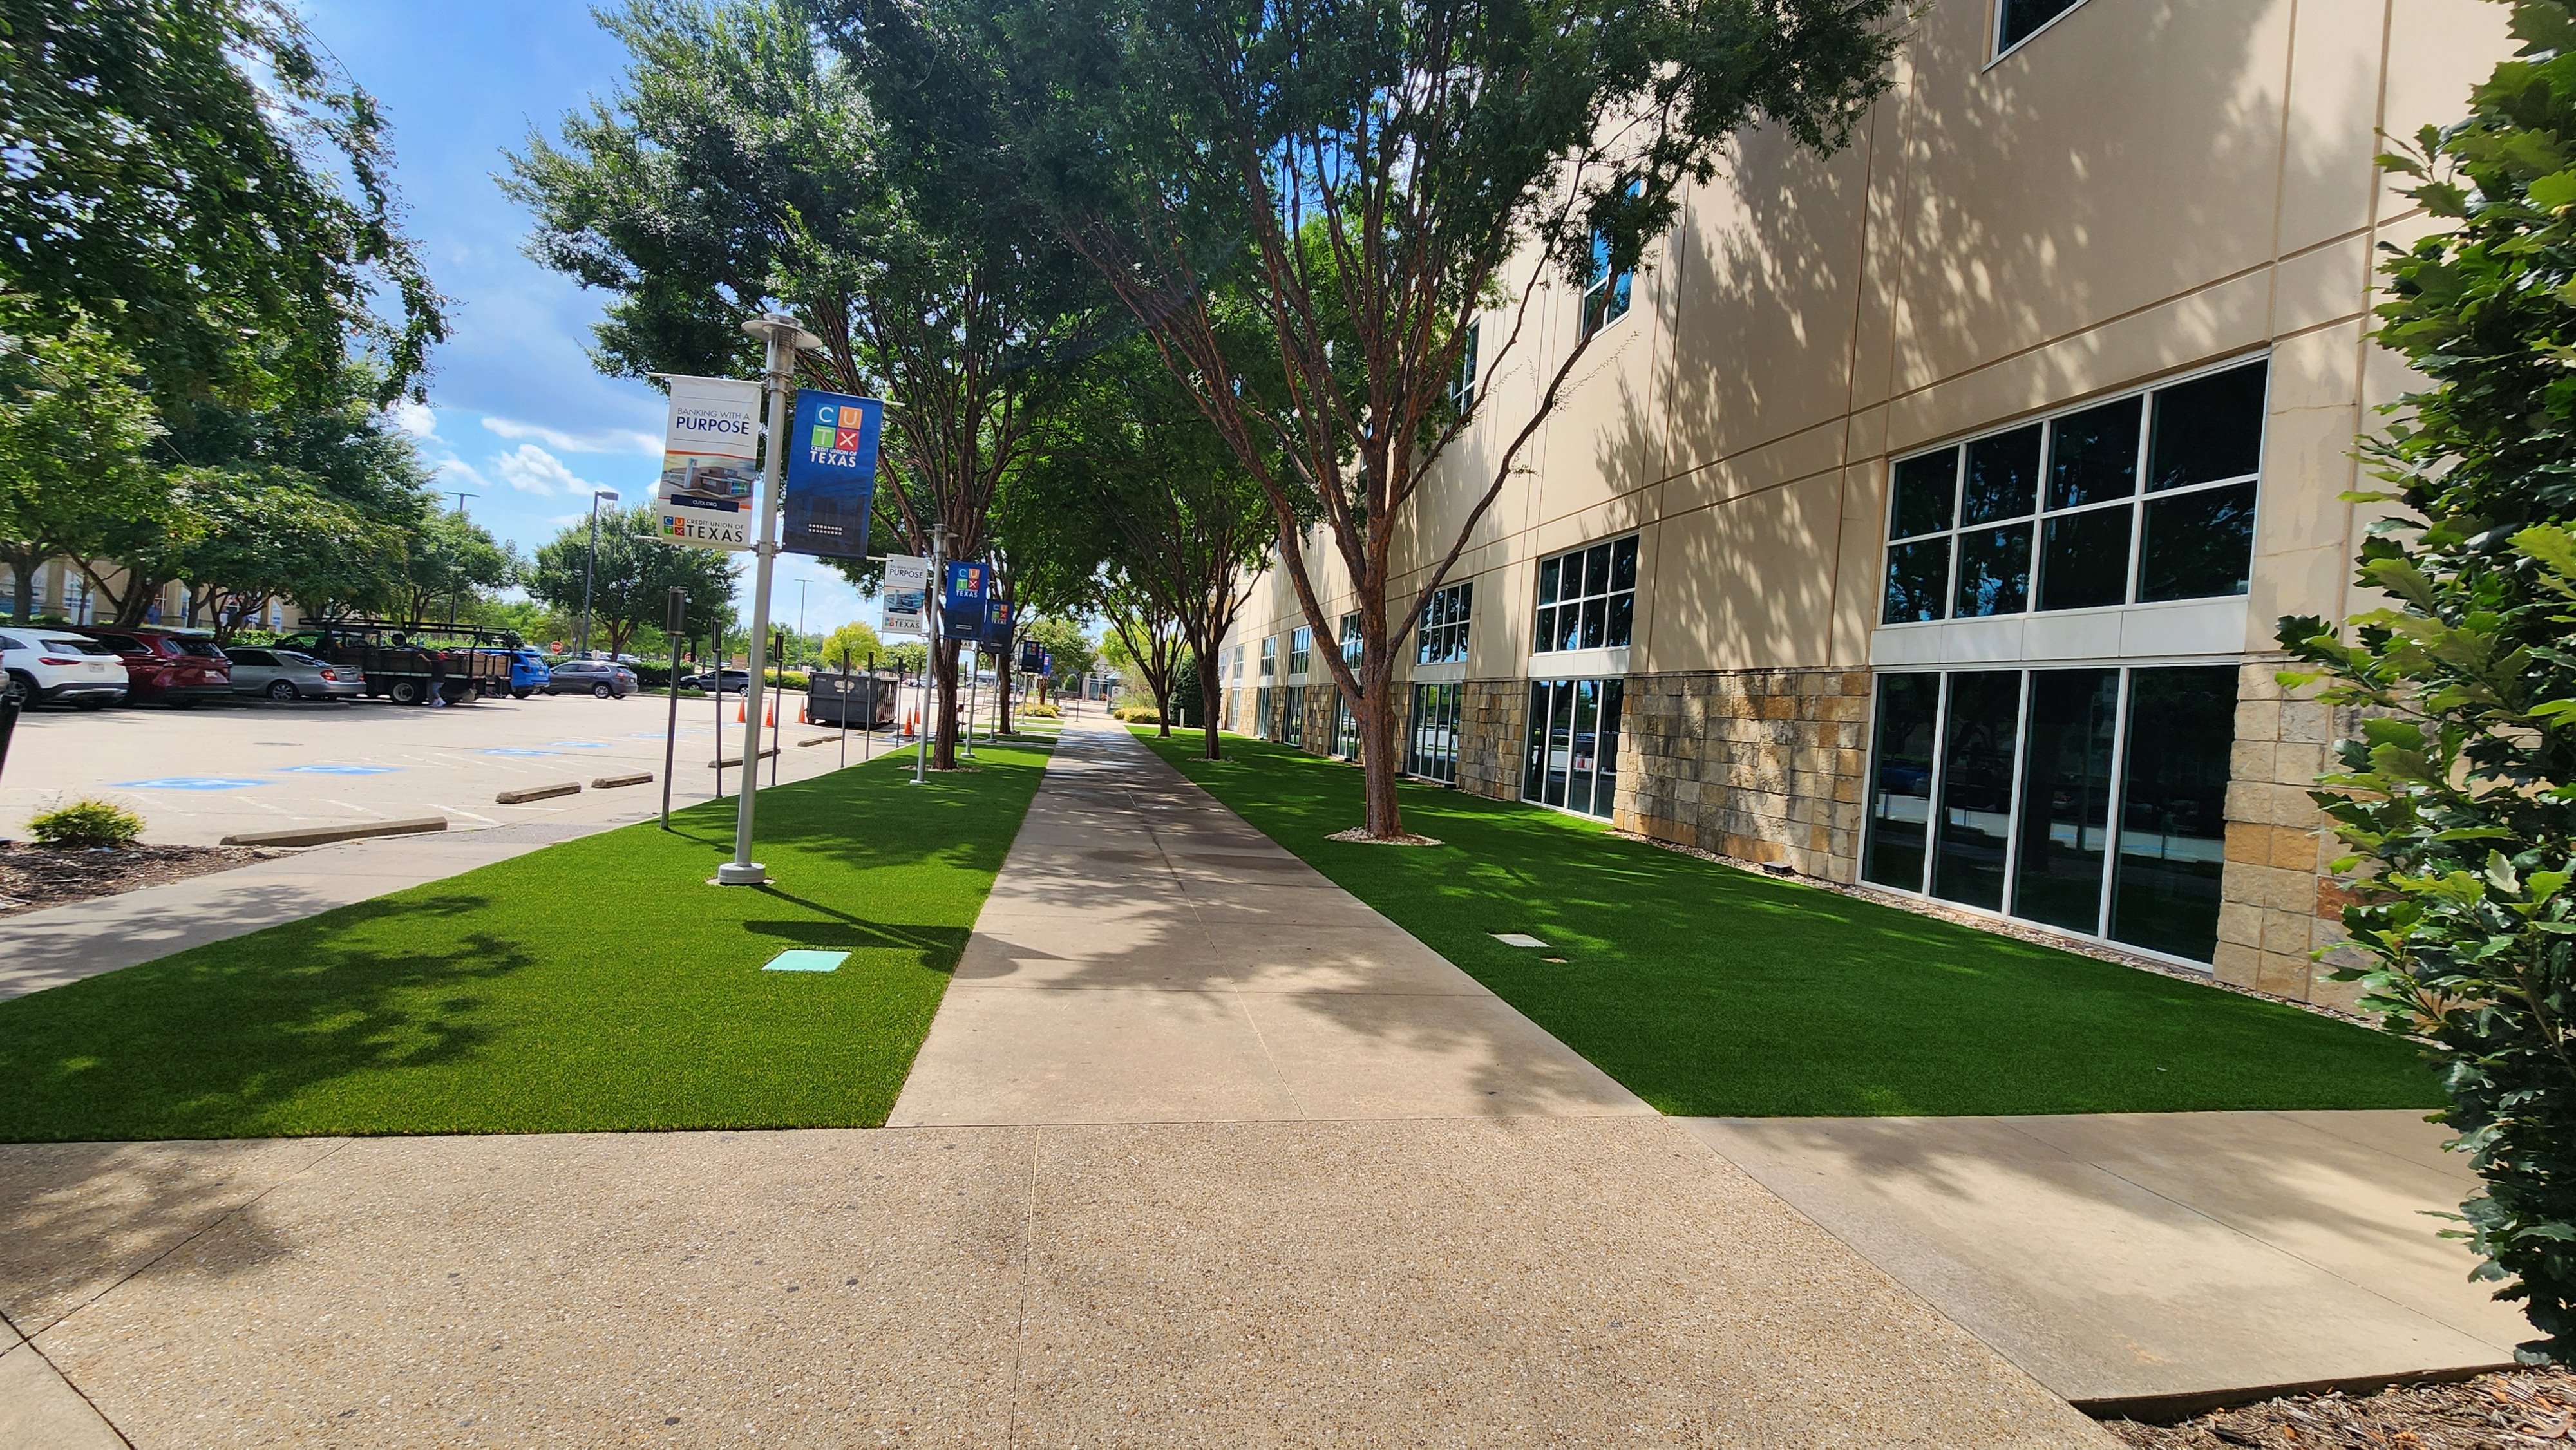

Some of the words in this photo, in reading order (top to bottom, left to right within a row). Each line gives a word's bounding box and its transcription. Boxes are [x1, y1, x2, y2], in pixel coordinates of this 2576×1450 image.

[677, 408, 717, 417] BANKING
[819, 406, 858, 426] CU
[676, 417, 750, 435] PURPOSE
[817, 428, 857, 447] TX
[810, 451, 857, 468] TEXAS
[665, 517, 683, 525] CU
[687, 525, 743, 543] TEXAS
[889, 569, 923, 579] PURPOSE
[959, 569, 977, 578] CU
[958, 580, 977, 588] TX
[956, 590, 978, 598] TEXAS
